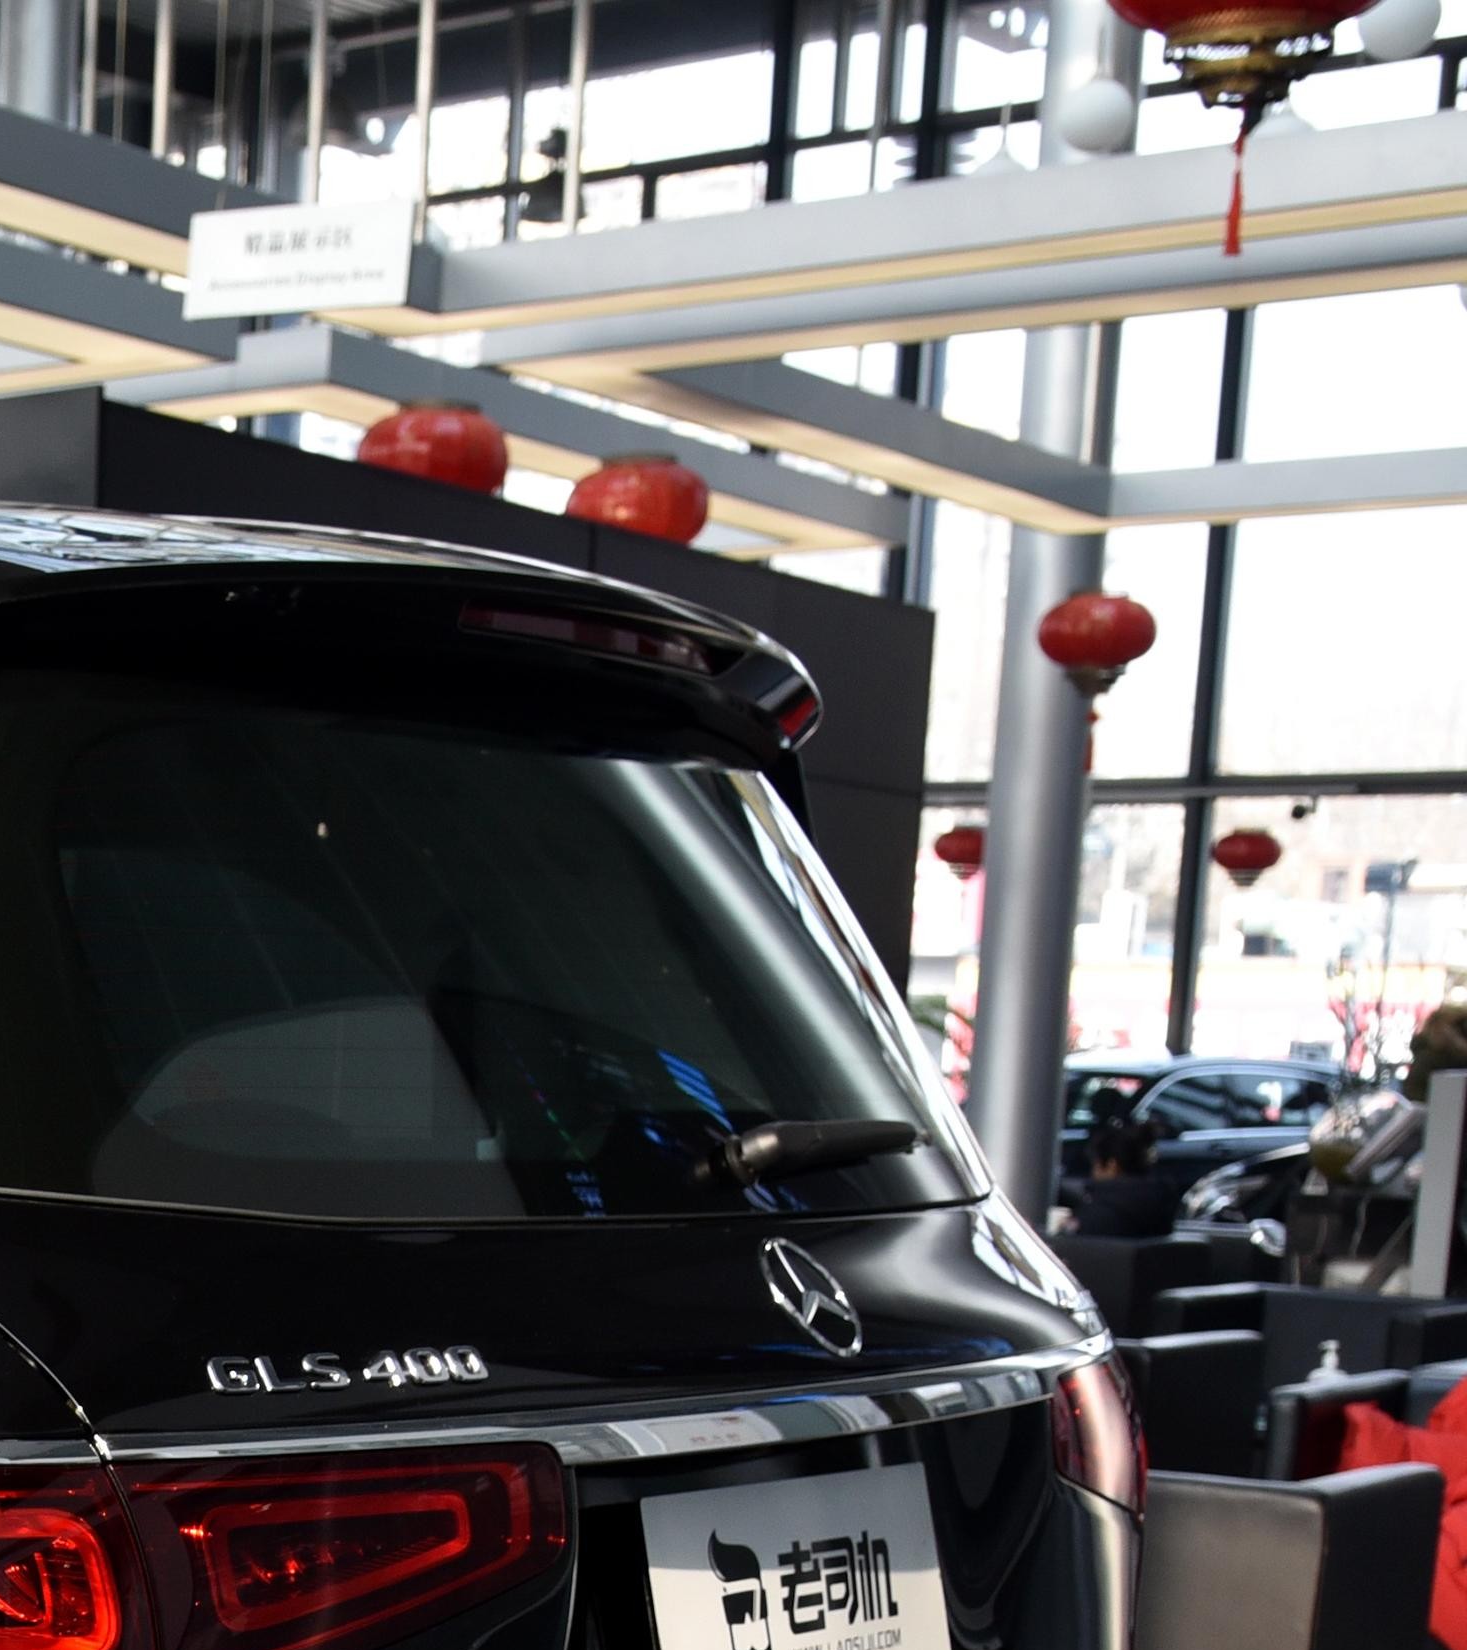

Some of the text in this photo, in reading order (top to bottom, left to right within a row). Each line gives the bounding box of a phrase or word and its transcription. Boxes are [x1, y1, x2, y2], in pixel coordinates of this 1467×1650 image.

[207, 1345, 489, 1393] GLS 400
[777, 1530, 898, 1635] 老司机
